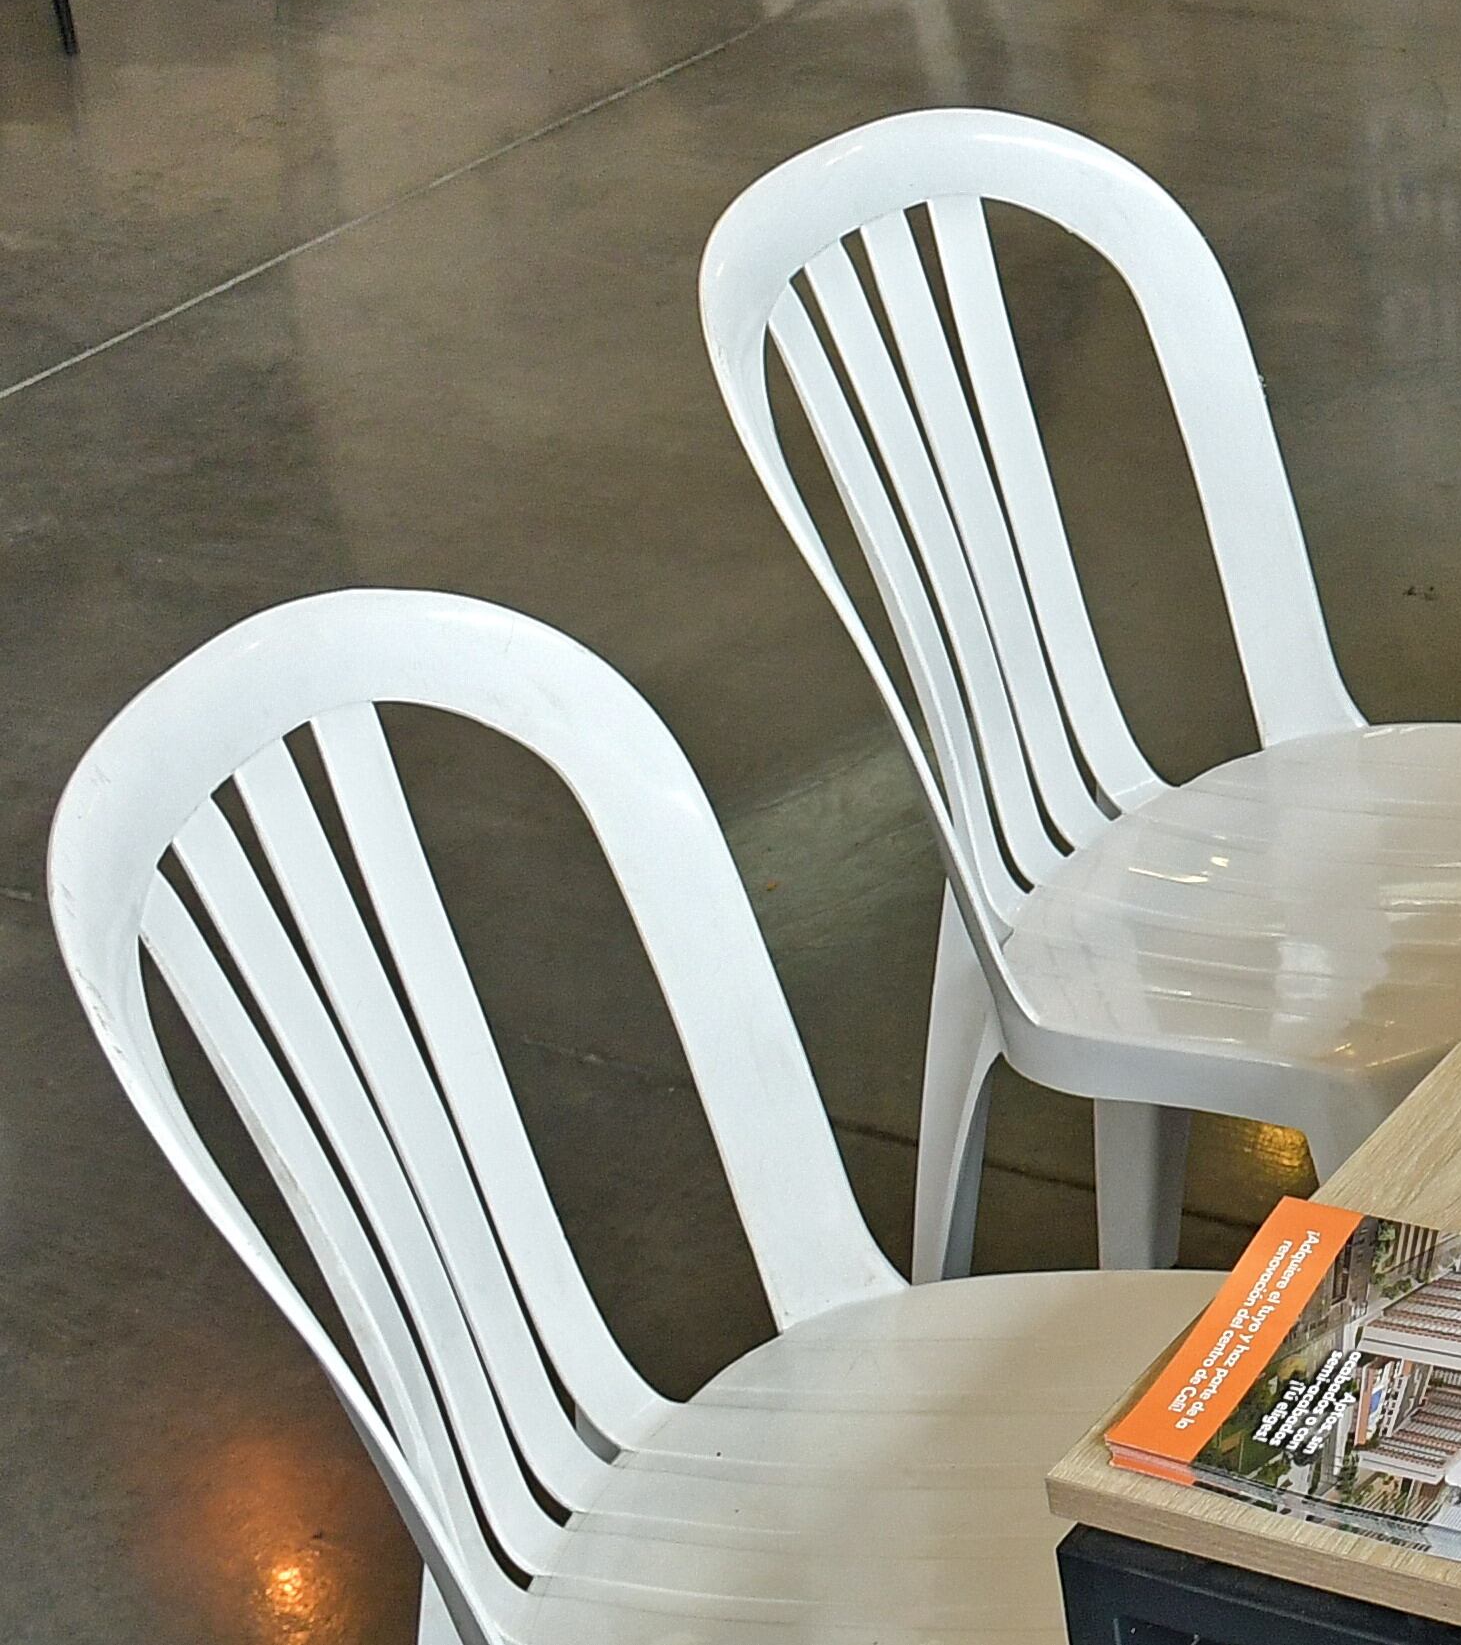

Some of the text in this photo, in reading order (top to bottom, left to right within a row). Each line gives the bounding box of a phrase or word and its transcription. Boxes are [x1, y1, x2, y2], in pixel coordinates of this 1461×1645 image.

[1243, 1239, 1294, 1307] renovación
[1174, 1230, 1320, 1430] ¡Adquiere el tuyo y haz parte de la
[1229, 1308, 1250, 1329] del
[1202, 1329, 1235, 1368] centro
[1189, 1368, 1209, 1386] de
[1268, 1349, 1343, 1447] semi-acabados
[1285, 1350, 1362, 1451] acabados o con
[1252, 1401, 1289, 1443] eliges!
[1302, 1435, 1325, 1455] sin
